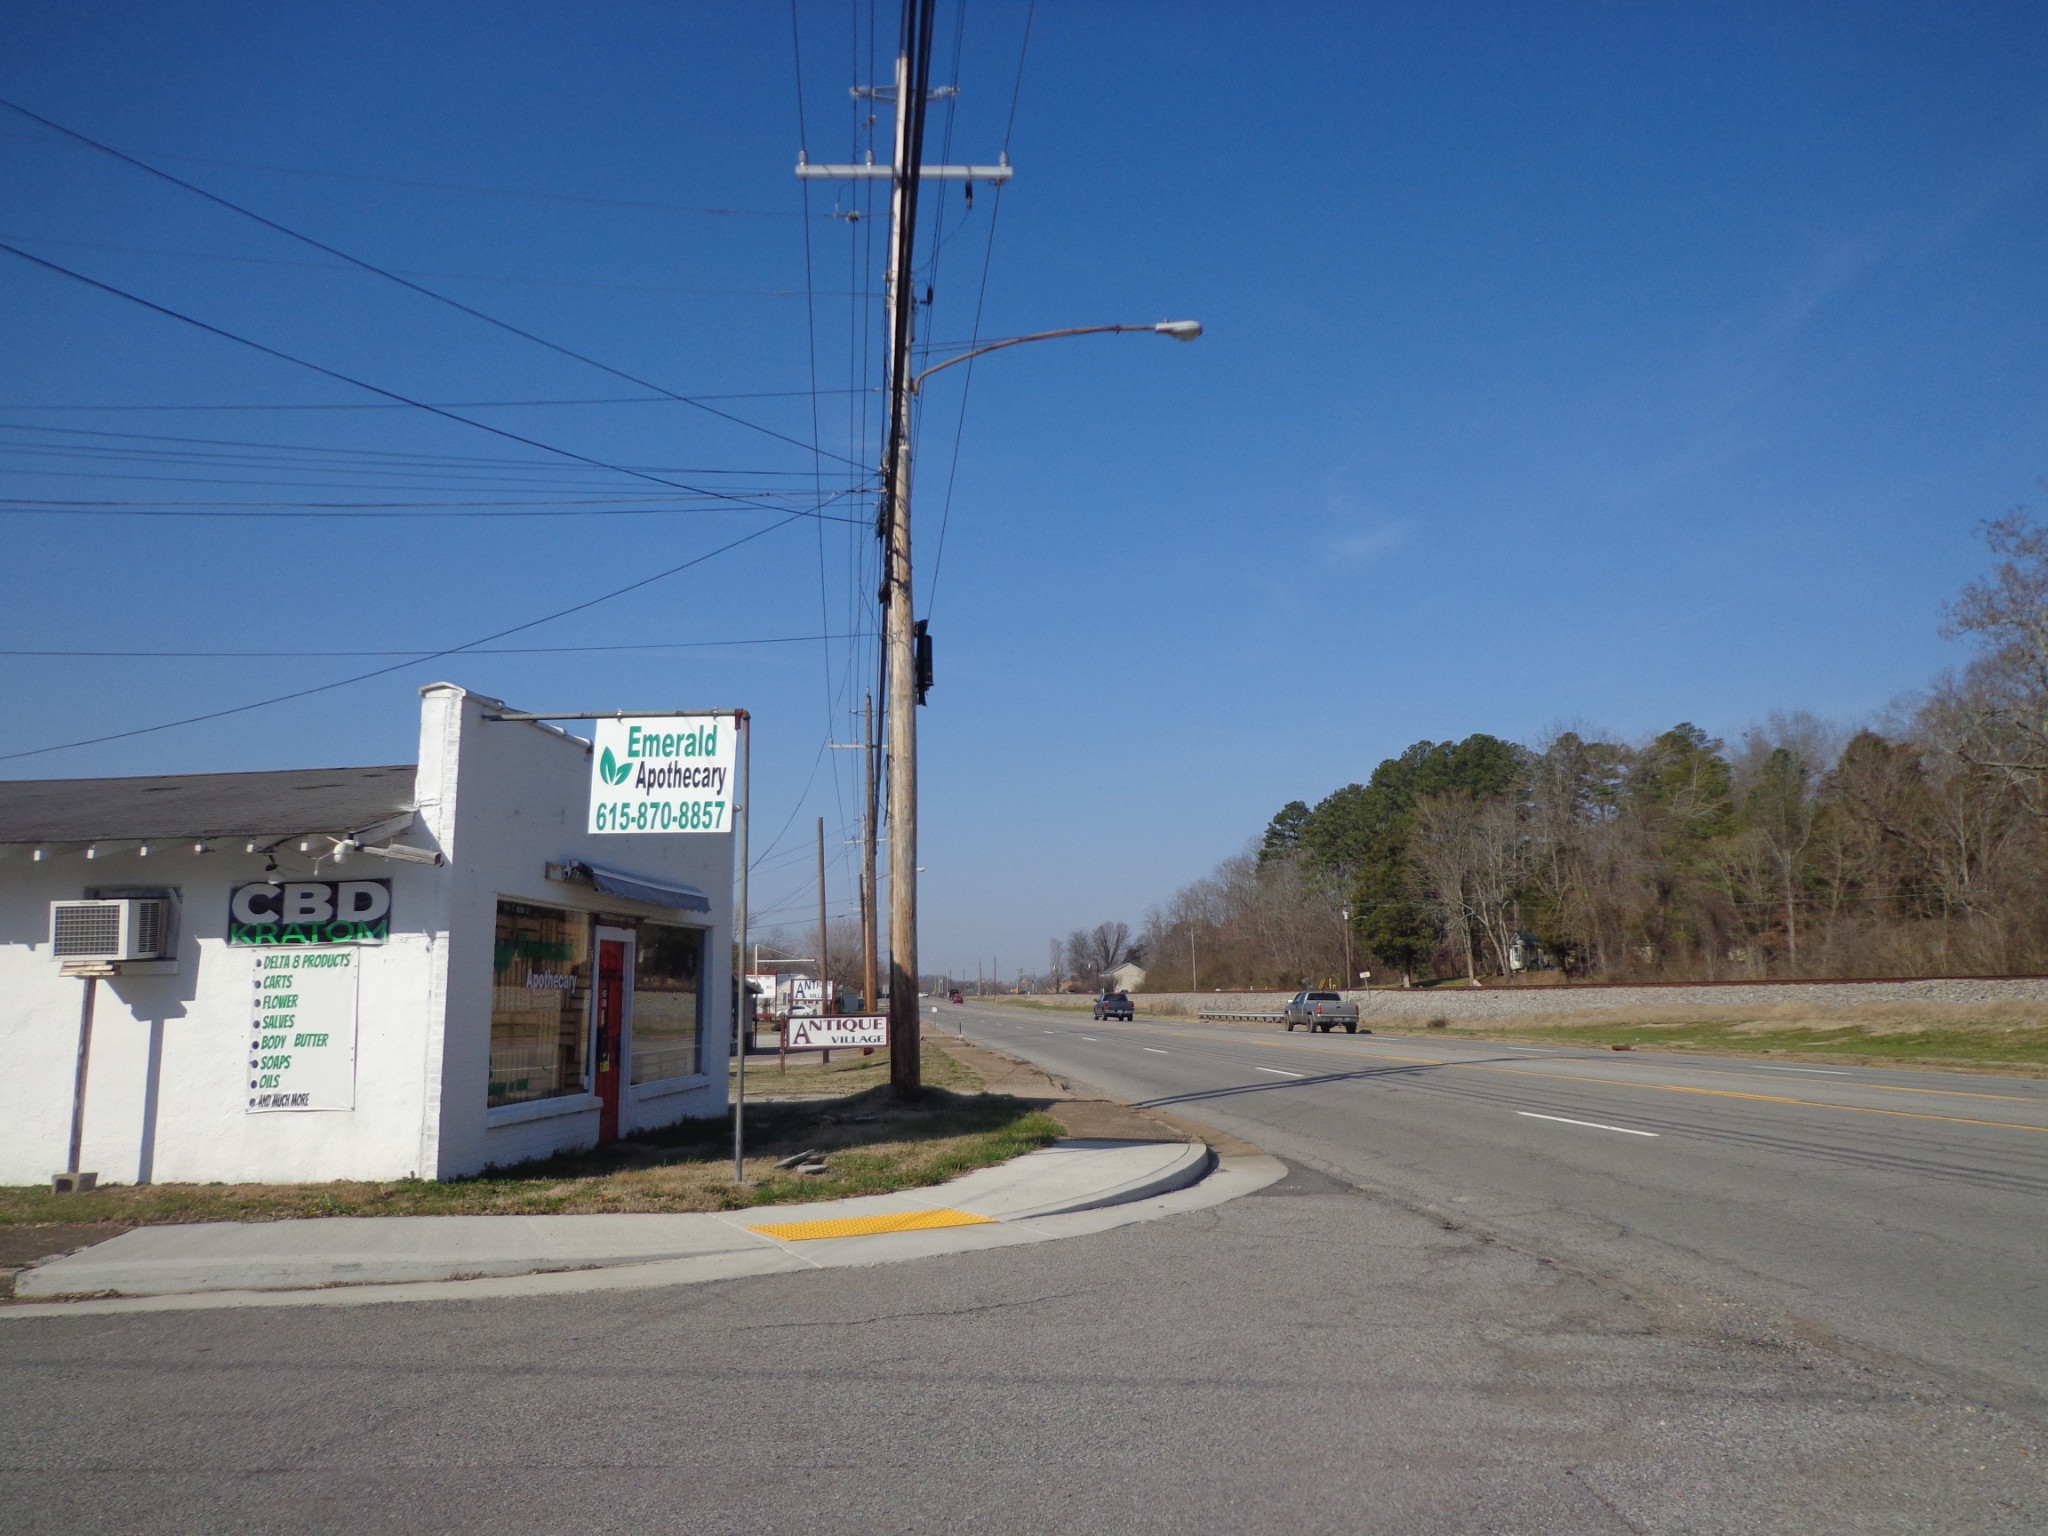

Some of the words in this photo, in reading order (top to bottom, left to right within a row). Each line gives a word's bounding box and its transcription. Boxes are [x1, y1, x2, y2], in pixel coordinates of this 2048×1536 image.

[627, 725, 718, 758] Emerald
[635, 760, 727, 796] Apothecary
[596, 801, 725, 831] 615-870-8857
[231, 881, 390, 924] CBD
[230, 920, 388, 944] KRATOM
[263, 955, 290, 969] DELTA
[292, 955, 300, 968] 8
[301, 953, 351, 968] PRODUCTS
[263, 975, 293, 989] CARTS
[526, 969, 577, 993] Apothecary
[795, 980, 832, 998] ANTIE
[262, 994, 298, 1009] FLOWER
[262, 1014, 295, 1029] SALVES
[792, 1018, 884, 1044] ANTIQUE
[260, 1035, 287, 1049] BODY
[294, 1033, 329, 1047] BUTTER
[831, 1035, 884, 1044] VILLAGE
[260, 1055, 291, 1069] SOAPS
[259, 1074, 280, 1088] OILS
[257, 1094, 272, 1107] AND
[272, 1093, 291, 1107] MUCH
[291, 1092, 310, 1106] MORE
